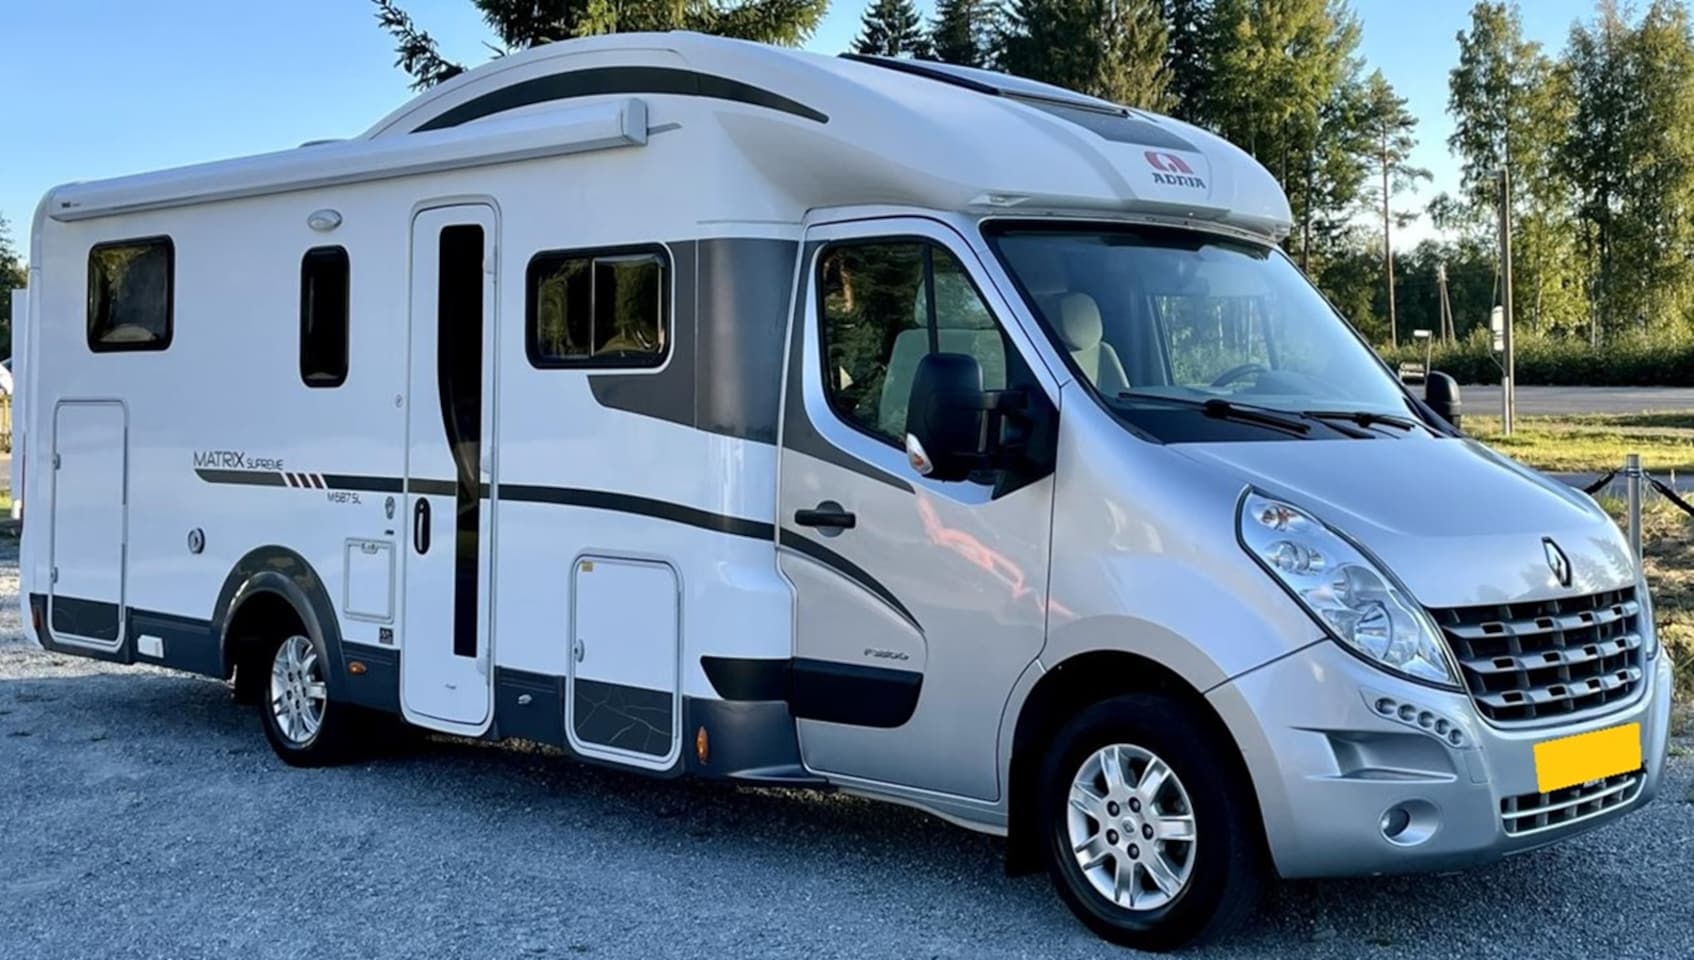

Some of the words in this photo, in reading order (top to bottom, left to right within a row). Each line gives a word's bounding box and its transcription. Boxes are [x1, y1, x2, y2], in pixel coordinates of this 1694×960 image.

[1152, 172, 1207, 189] ADRIA
[193, 451, 245, 468] MATRIX
[246, 457, 284, 470] SUPREME
